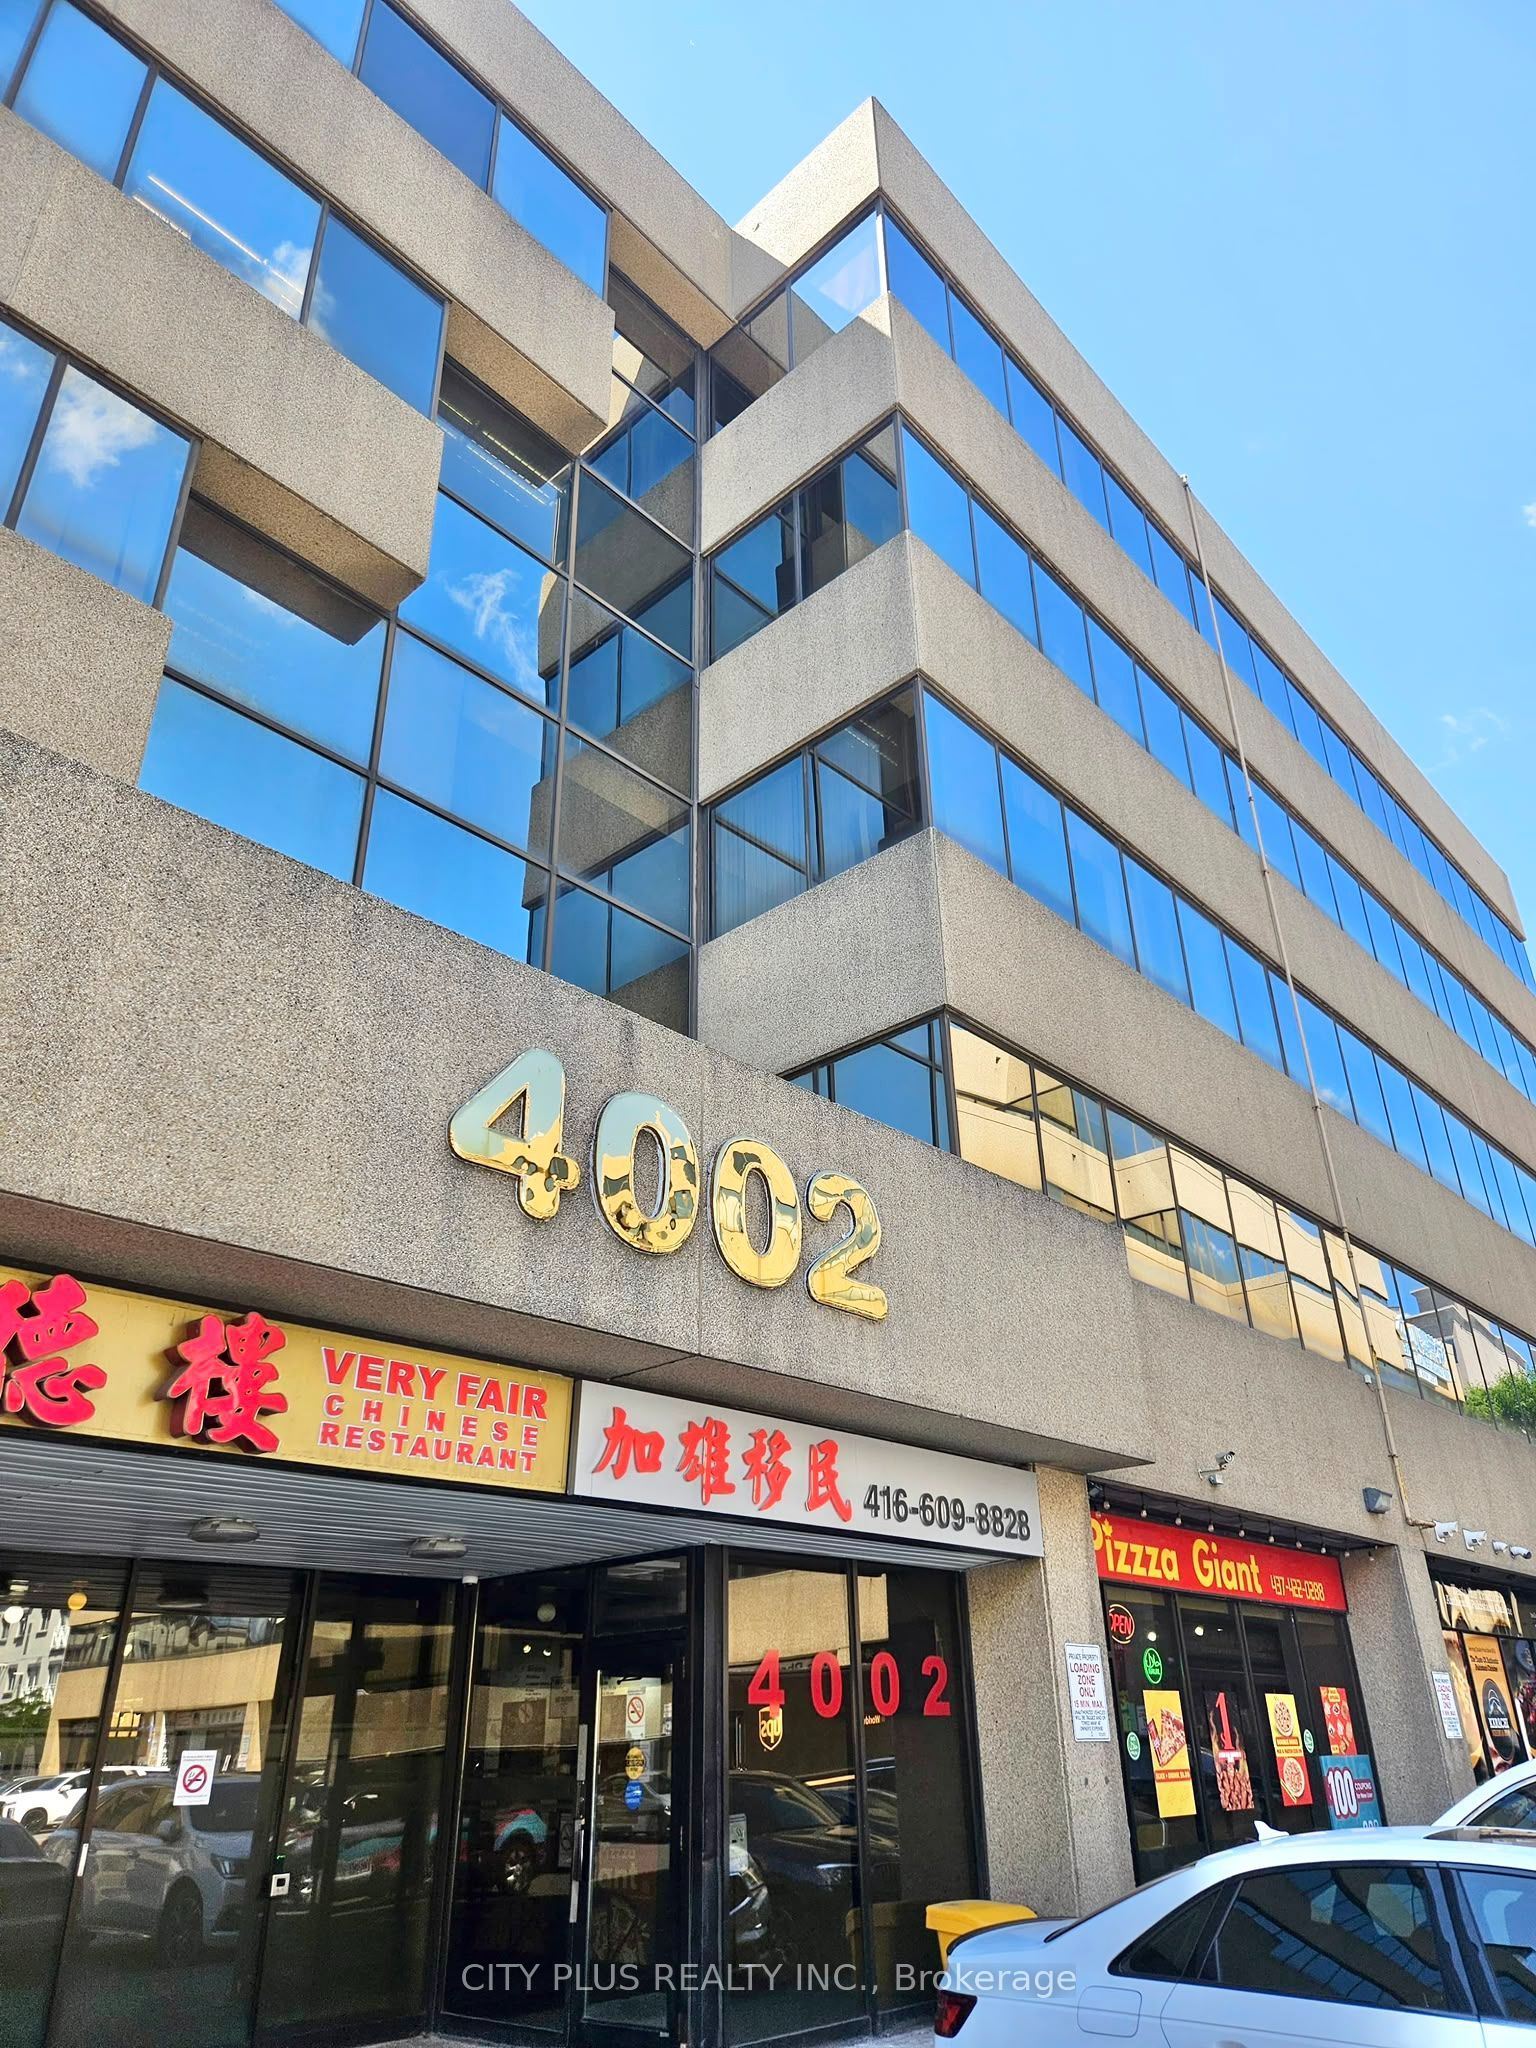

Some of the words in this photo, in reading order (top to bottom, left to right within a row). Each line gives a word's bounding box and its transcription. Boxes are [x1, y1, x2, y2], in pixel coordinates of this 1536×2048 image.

[447, 1047, 888, 1321] 4002
[321, 1346, 447, 1400] VERY
[456, 1373, 548, 1420] FAIR
[323, 1393, 538, 1447] CHINESE
[319, 1421, 538, 1473] RESTAURANT
[592, 1406, 853, 1522] 加雄移民
[863, 1484, 1031, 1541] 416-609-8828
[1191, 1538, 1263, 1595] Giant
[1270, 1575, 1325, 1602] 437-422-0288
[1069, 1662, 1100, 1674] LOADING
[1077, 1675, 1096, 1686] ZONE
[1079, 1686, 1096, 1698] ONLY
[1328, 1769, 1358, 1816] 100
